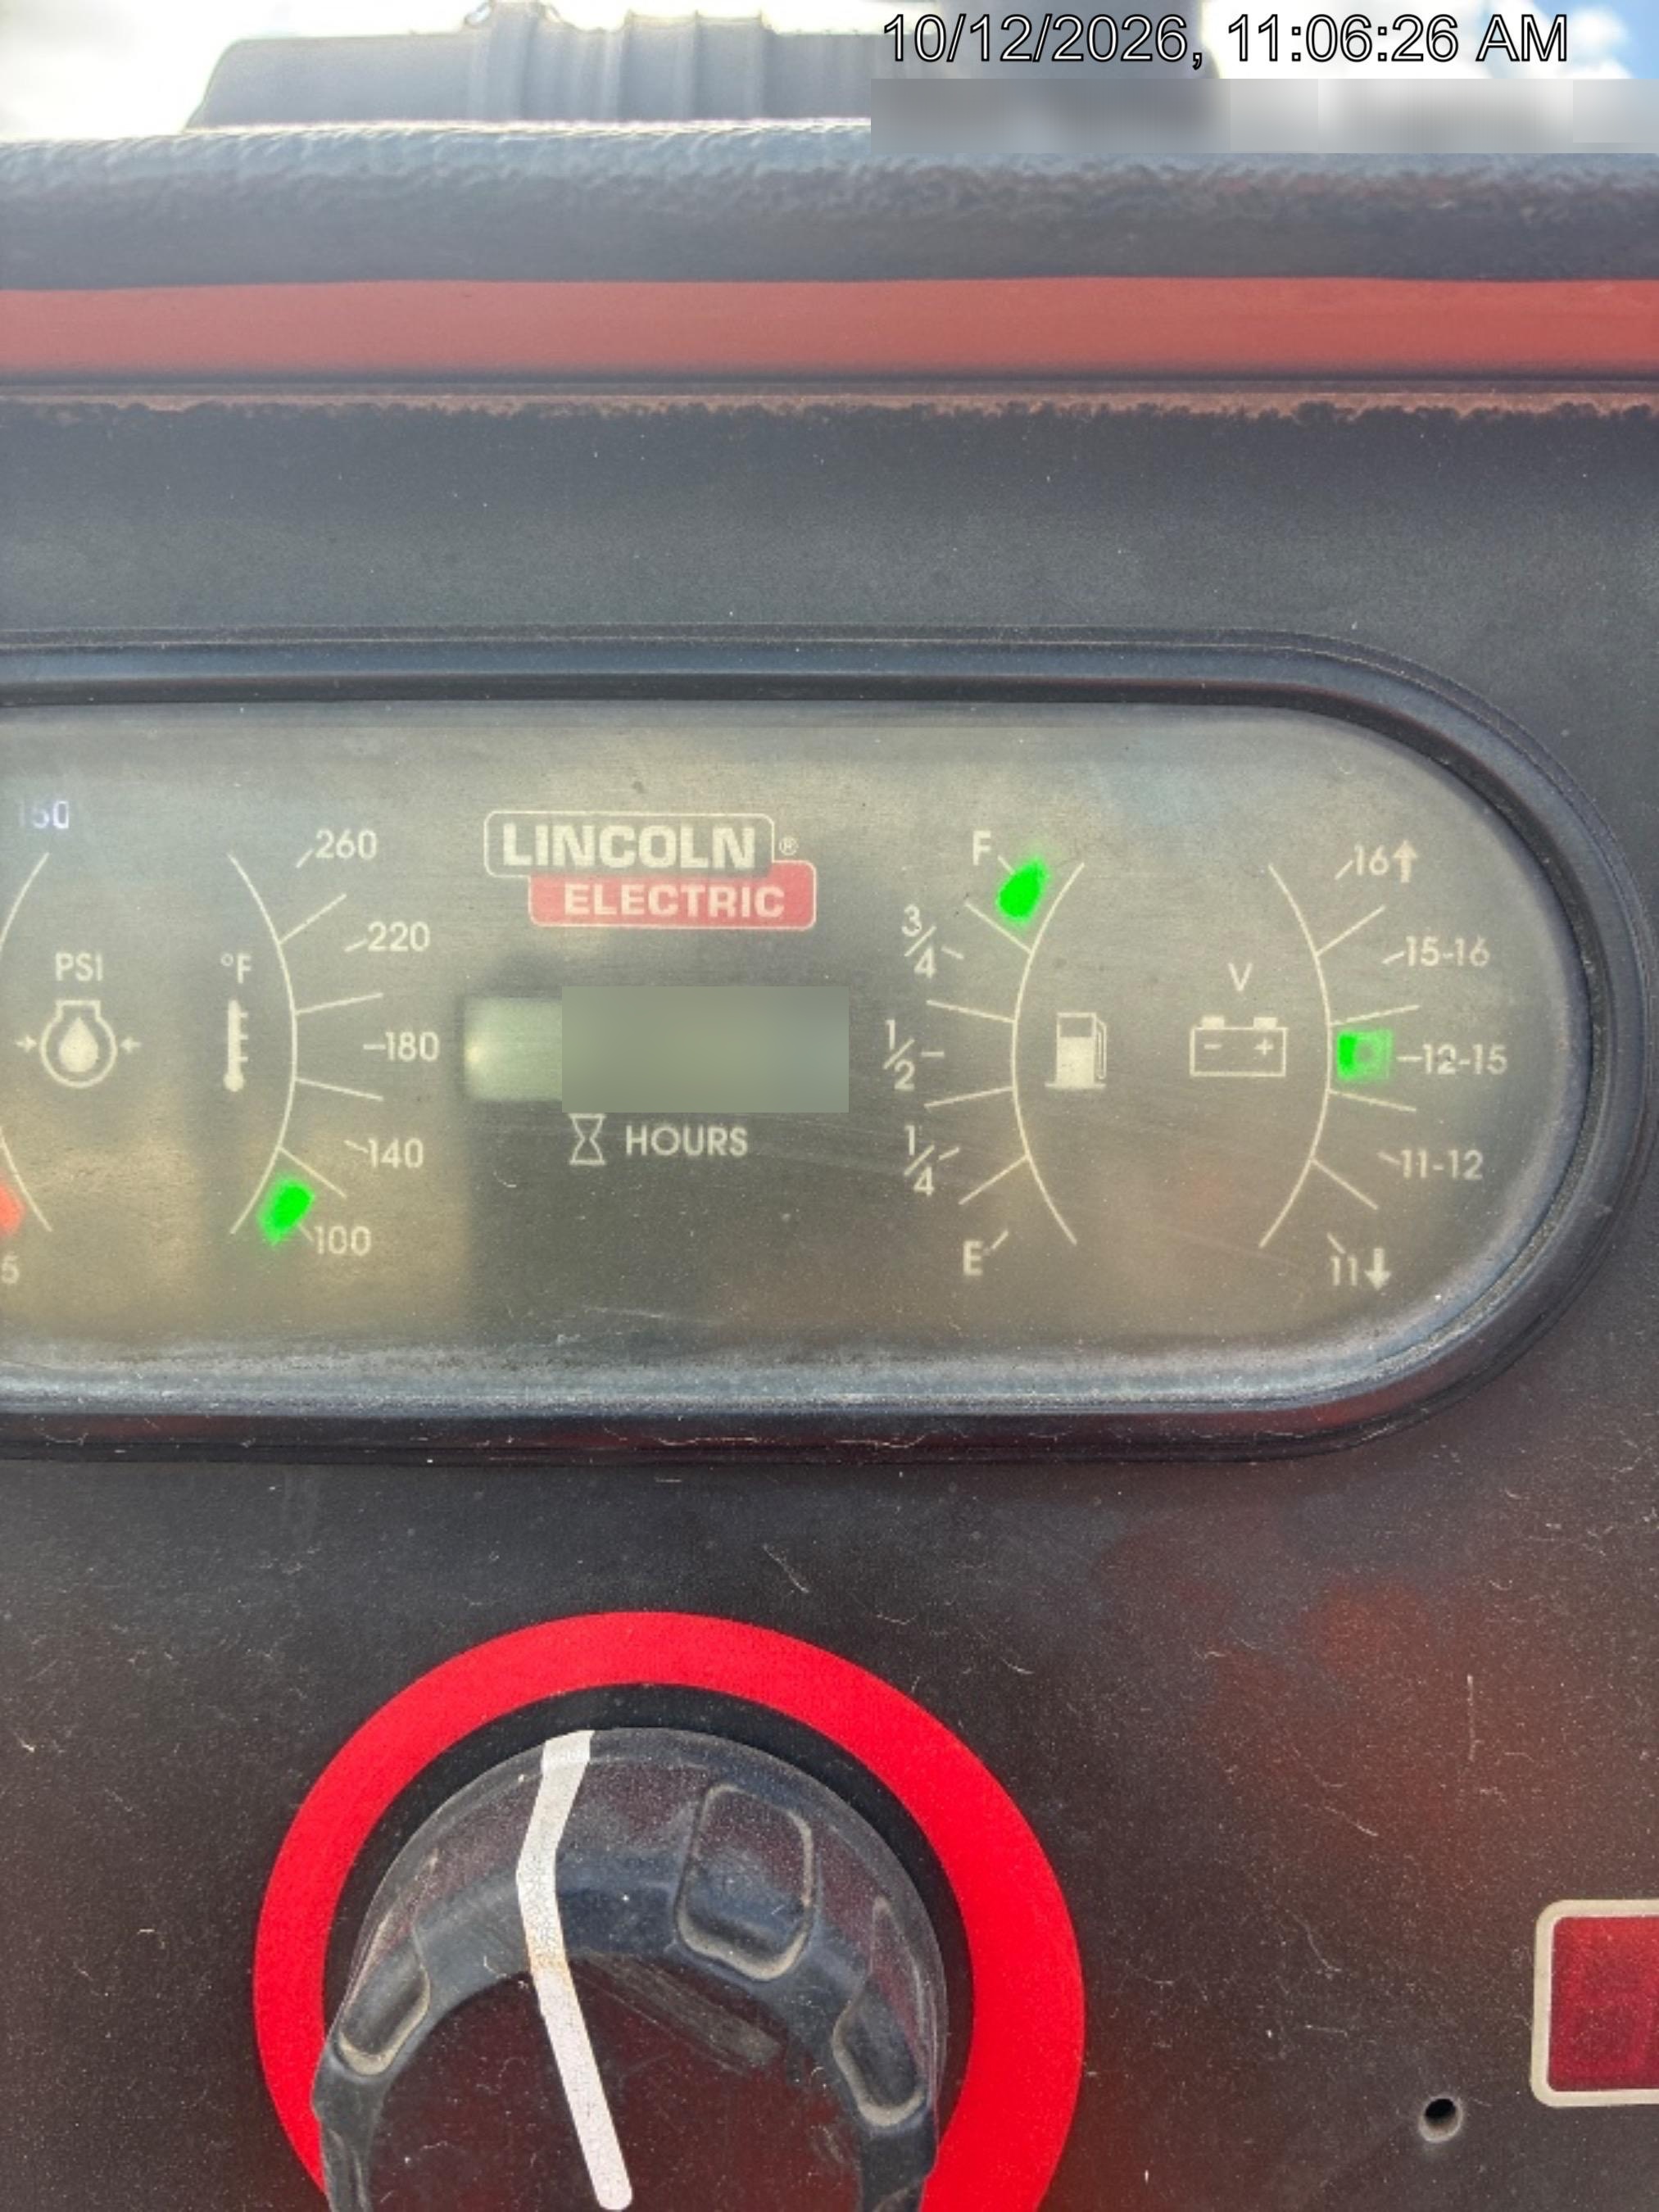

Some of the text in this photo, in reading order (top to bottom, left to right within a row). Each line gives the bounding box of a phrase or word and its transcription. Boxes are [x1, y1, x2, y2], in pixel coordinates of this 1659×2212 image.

[315, 829, 378, 860] 260
[502, 823, 755, 869] LINCOLN
[972, 830, 991, 866] F
[1354, 845, 1389, 877] 16
[564, 883, 786, 918] ELECTRIC
[368, 922, 431, 953] 220
[1406, 936, 1490, 968] 15-16
[55, 953, 103, 982] PSI
[1229, 962, 1253, 992] V
[386, 1031, 440, 1062] 180
[1422, 1044, 1508, 1076] 12-15
[368, 1138, 424, 1169] 140
[625, 1125, 749, 1157] HOURS
[1401, 1149, 1484, 1181] 11-12
[314, 1226, 372, 1256] 100
[963, 1240, 983, 1276] E
[1330, 1256, 1358, 1287] 11
